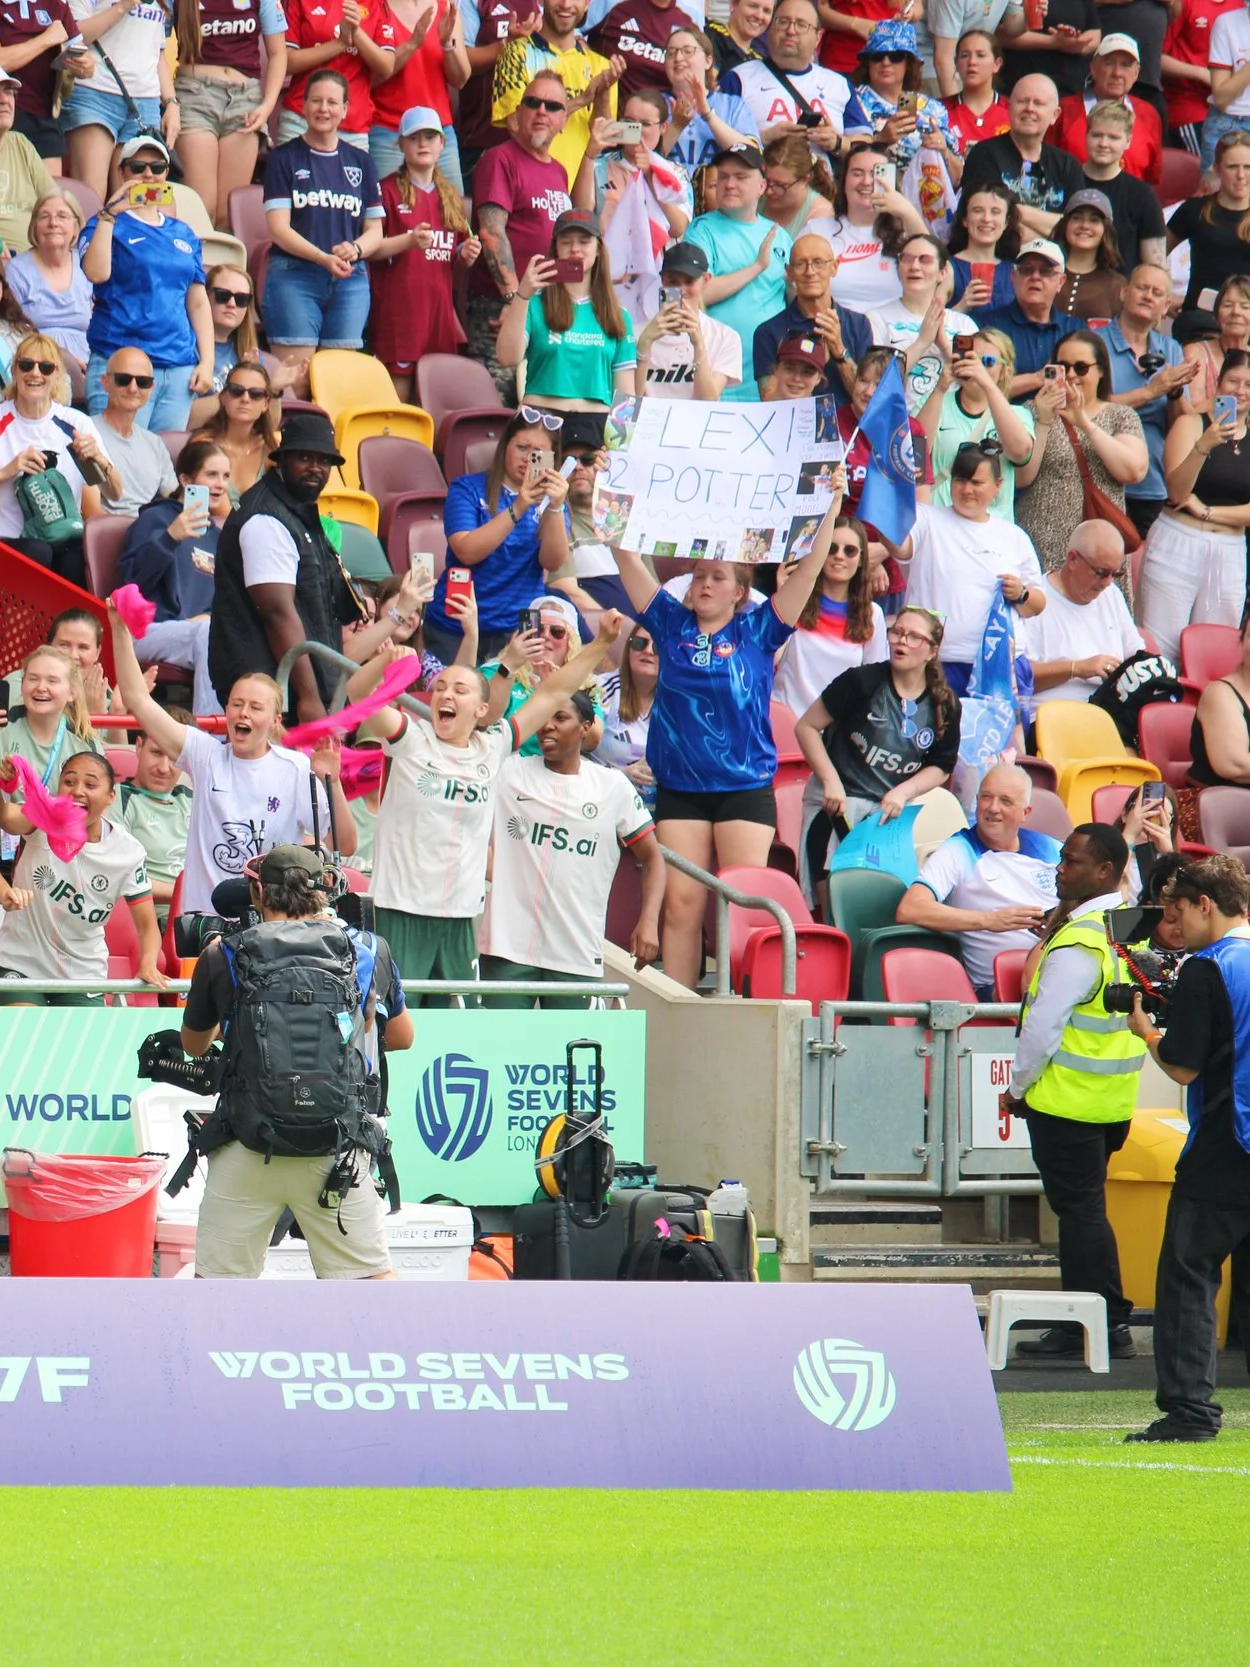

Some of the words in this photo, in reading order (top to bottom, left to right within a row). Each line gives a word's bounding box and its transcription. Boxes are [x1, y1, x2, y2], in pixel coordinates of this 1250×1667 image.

[201, 17, 256, 37] etano
[292, 189, 362, 217] betway
[422, 230, 454, 249] YLE
[646, 364, 694, 383] nik
[659, 403, 795, 457] LEXI
[647, 463, 795, 511] POTTER
[1116, 658, 1162, 703] JUST
[531, 822, 600, 858] IFS.ai
[50, 879, 114, 924] IFS.ai
[505, 1064, 606, 1086] WORLD
[990, 1059, 1012, 1086] GAT
[6, 1093, 132, 1121] WORLD
[507, 1089, 617, 1111] SEVENS
[507, 1135, 541, 1152] LON
[434, 1229, 458, 1238] ETTER
[207, 1351, 407, 1379] WORLD
[416, 1352, 630, 1382] SEVENS
[281, 1382, 569, 1412] FOOTBALL
